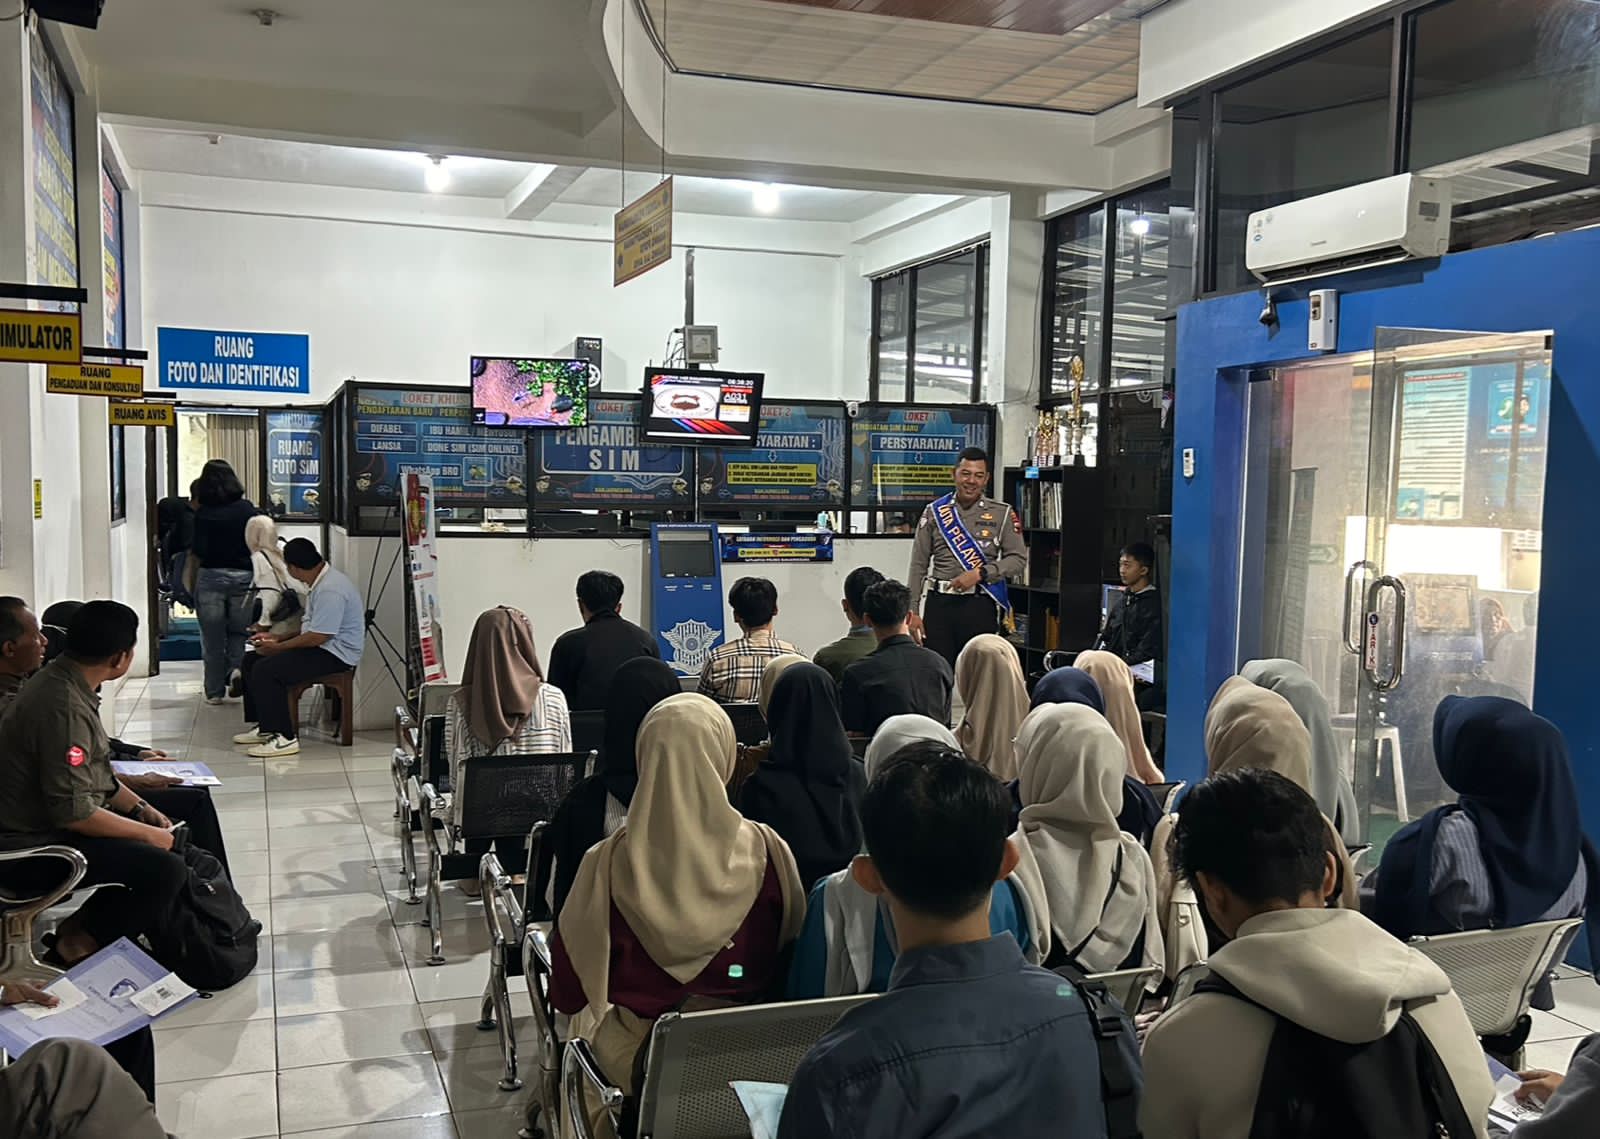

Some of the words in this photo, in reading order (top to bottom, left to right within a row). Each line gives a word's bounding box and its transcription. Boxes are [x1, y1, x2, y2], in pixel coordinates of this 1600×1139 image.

[215, 336, 254, 358] RUANG
[80, 366, 111, 378] RUANG
[168, 361, 198, 383] FOTO
[200, 362, 224, 384] DAN
[226, 364, 300, 388] IDENTIFIKASI
[50, 378, 88, 391] PENGADUAN
[89, 381, 102, 391] DAN
[103, 382, 140, 393] KONSULTASI
[402, 393, 432, 405] LOKET
[114, 407, 145, 420] RUANG
[147, 408, 167, 420] AVIS
[357, 404, 411, 416] PENDAFTARAN
[784, 407, 792, 416] 2
[904, 411, 929, 421] LOKET
[370, 423, 403, 434] DIFABEL
[430, 425, 443, 435] IBU
[278, 439, 312, 456] RUANG
[372, 441, 402, 451] LANSIA
[880, 436, 953, 450] PERSYARATAN
[589, 448, 640, 471] SIM
[272, 459, 297, 475] FOTO
[299, 460, 319, 475] SIM
